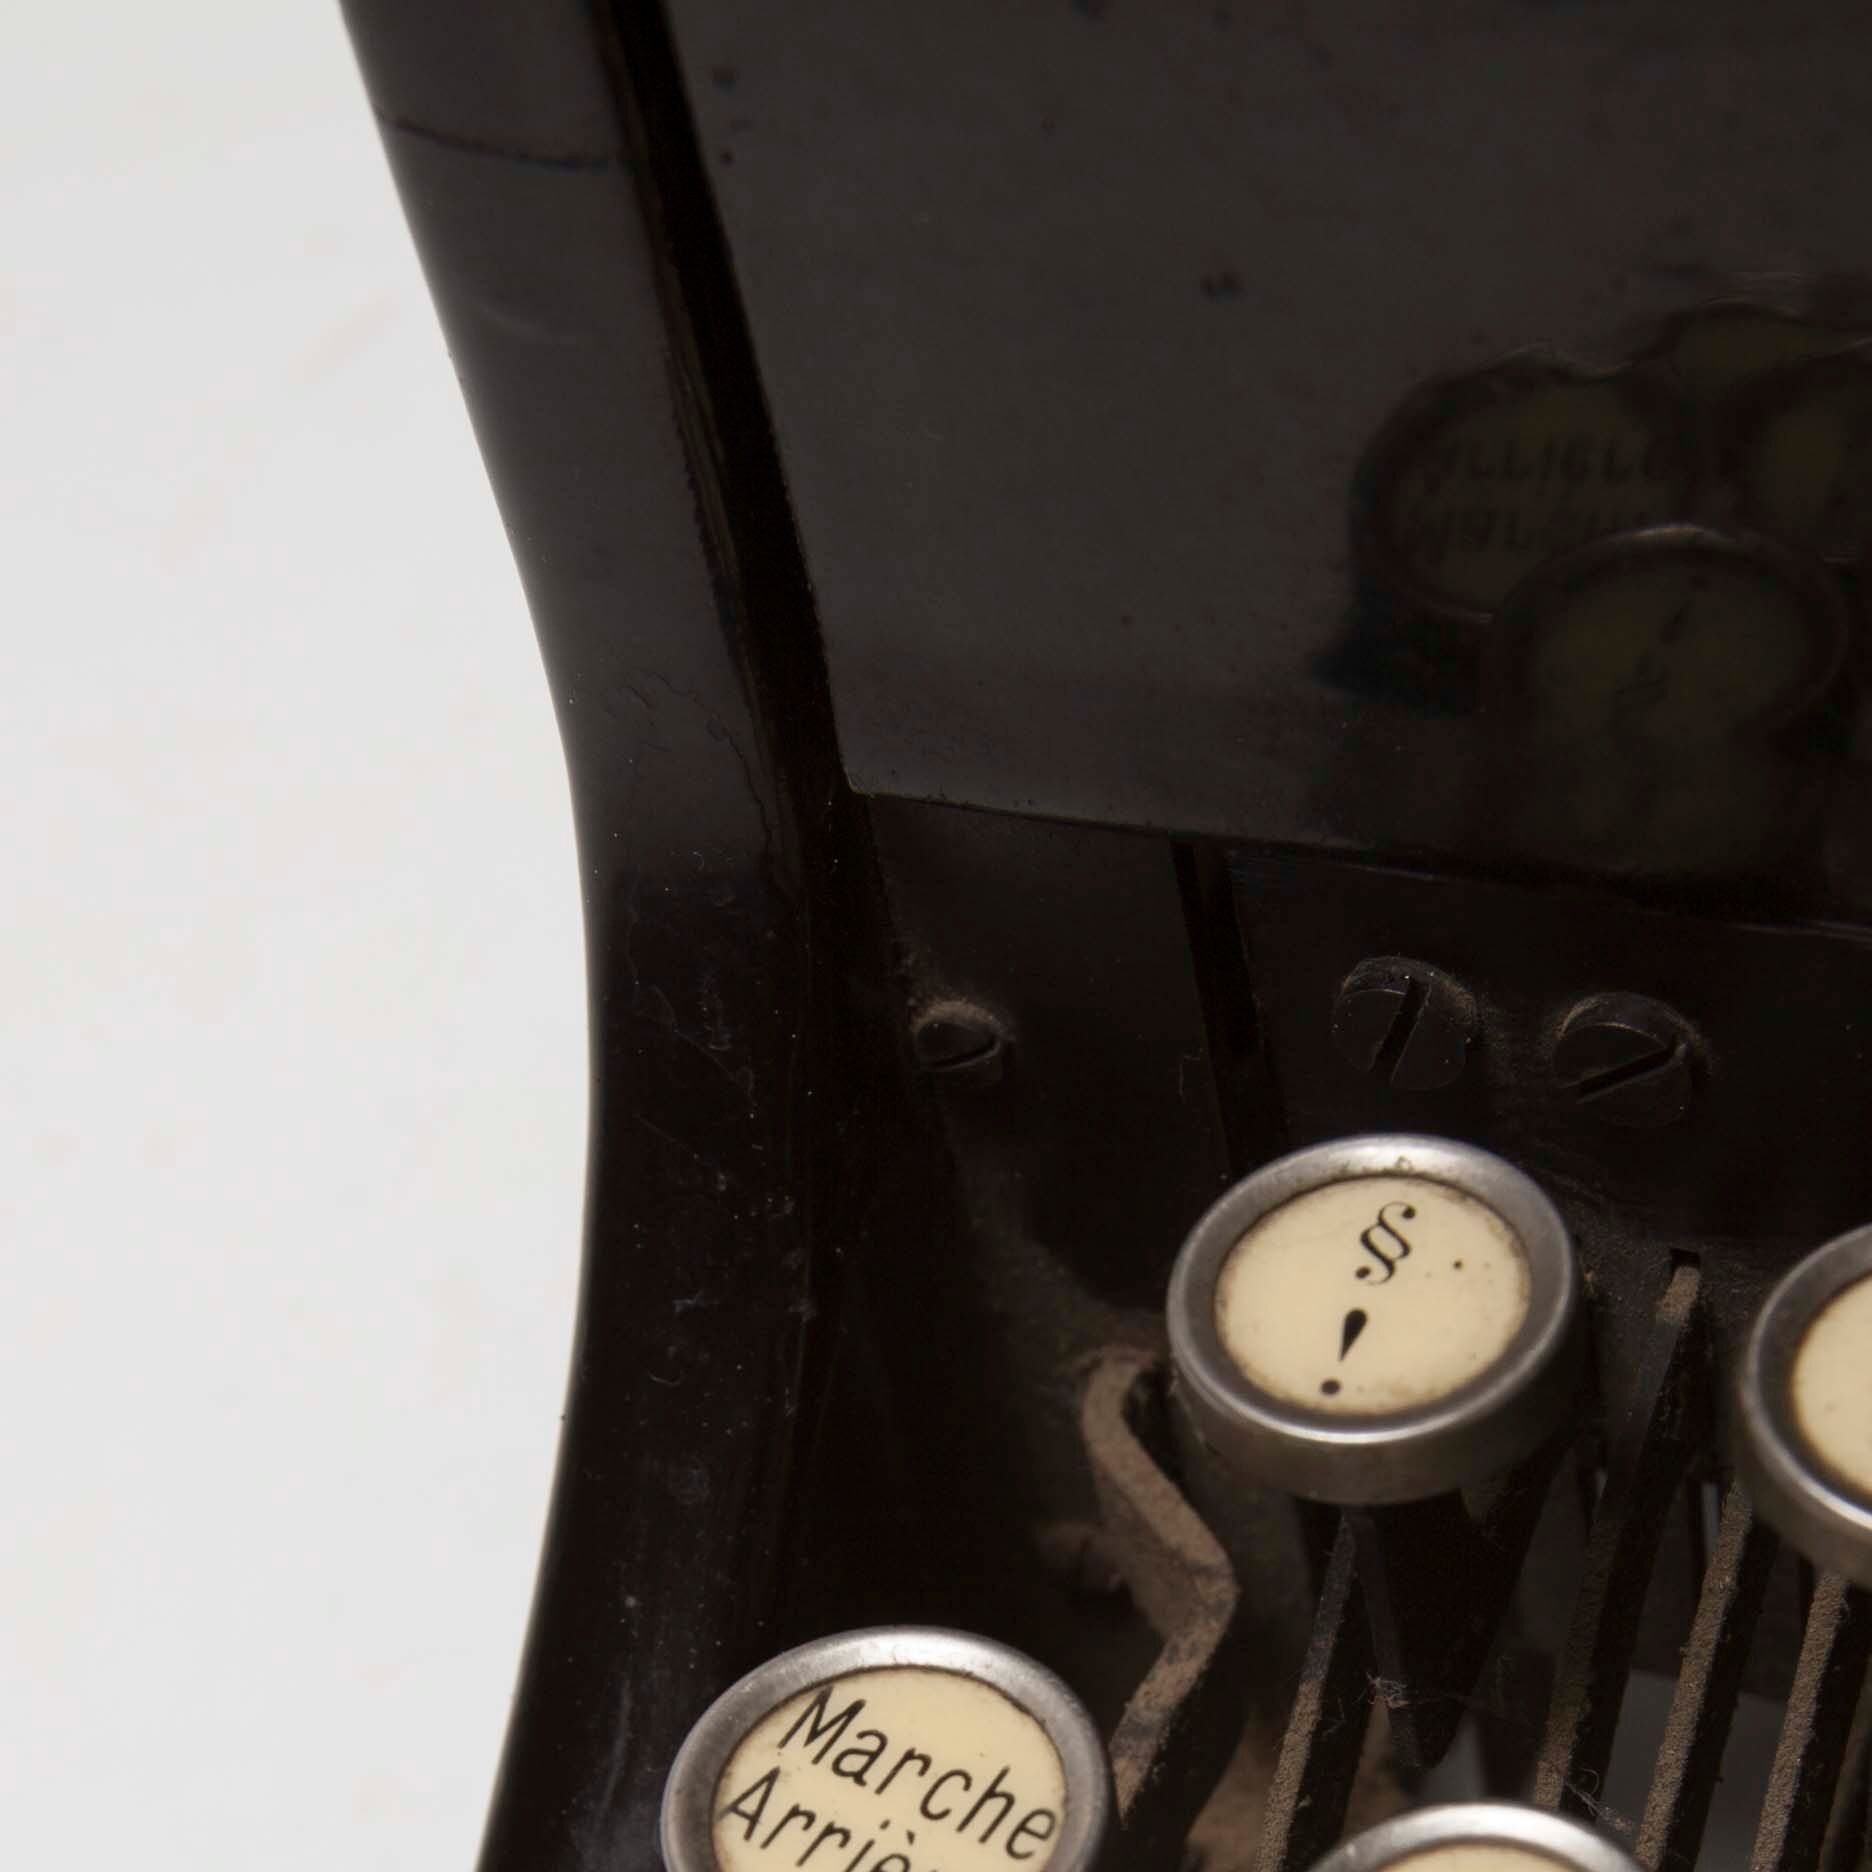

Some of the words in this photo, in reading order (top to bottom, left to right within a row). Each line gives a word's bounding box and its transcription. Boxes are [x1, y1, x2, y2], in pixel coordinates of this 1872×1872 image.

[1356, 1202, 1418, 1284] §
[1320, 1308, 1369, 1396] !
[777, 1685, 1058, 1860] Marche
